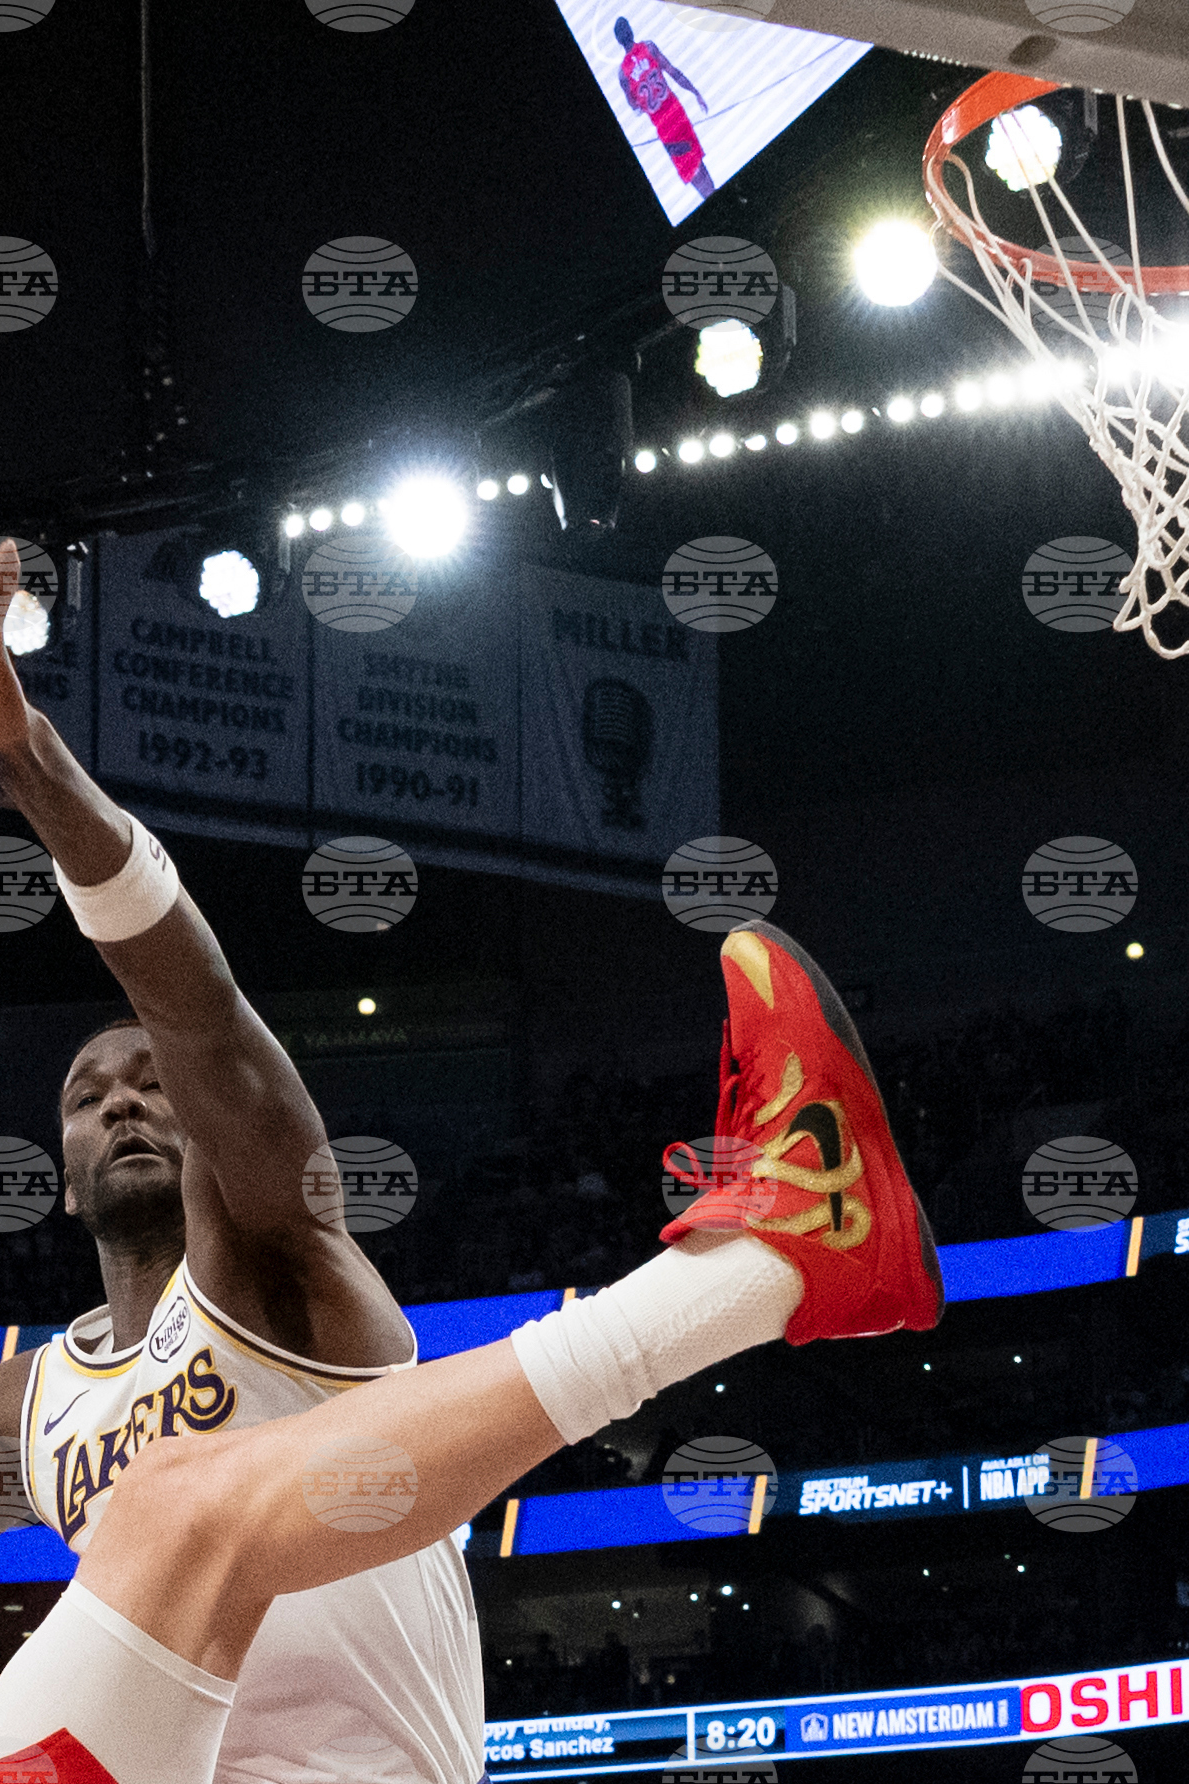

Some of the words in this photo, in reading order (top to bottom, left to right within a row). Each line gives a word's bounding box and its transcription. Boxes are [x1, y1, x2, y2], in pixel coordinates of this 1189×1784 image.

[131, 616, 278, 664] CAMPBELL
[553, 608, 689, 662] MILLER
[114, 650, 295, 699] CONFERENCE
[122, 684, 286, 733] CHAMPIONS
[357, 685, 478, 725] DIVISION
[138, 730, 269, 781] 1992-93
[337, 717, 498, 765] CHAMPIONS
[356, 763, 480, 806] 1990-91
[52, 1346, 238, 1550] LAKERS
[799, 1480, 953, 1516] SPORTSNET+
[980, 1469, 1015, 1501] NBA
[1016, 1465, 1050, 1497] APP
[832, 1711, 876, 1740] NEW
[876, 1701, 994, 1737] AMSTERDAM
[1020, 1667, 1183, 1733] OSHI
[484, 1741, 525, 1762] rcos
[529, 1736, 615, 1759] Sanchez
[706, 1716, 777, 1751] 8:20
